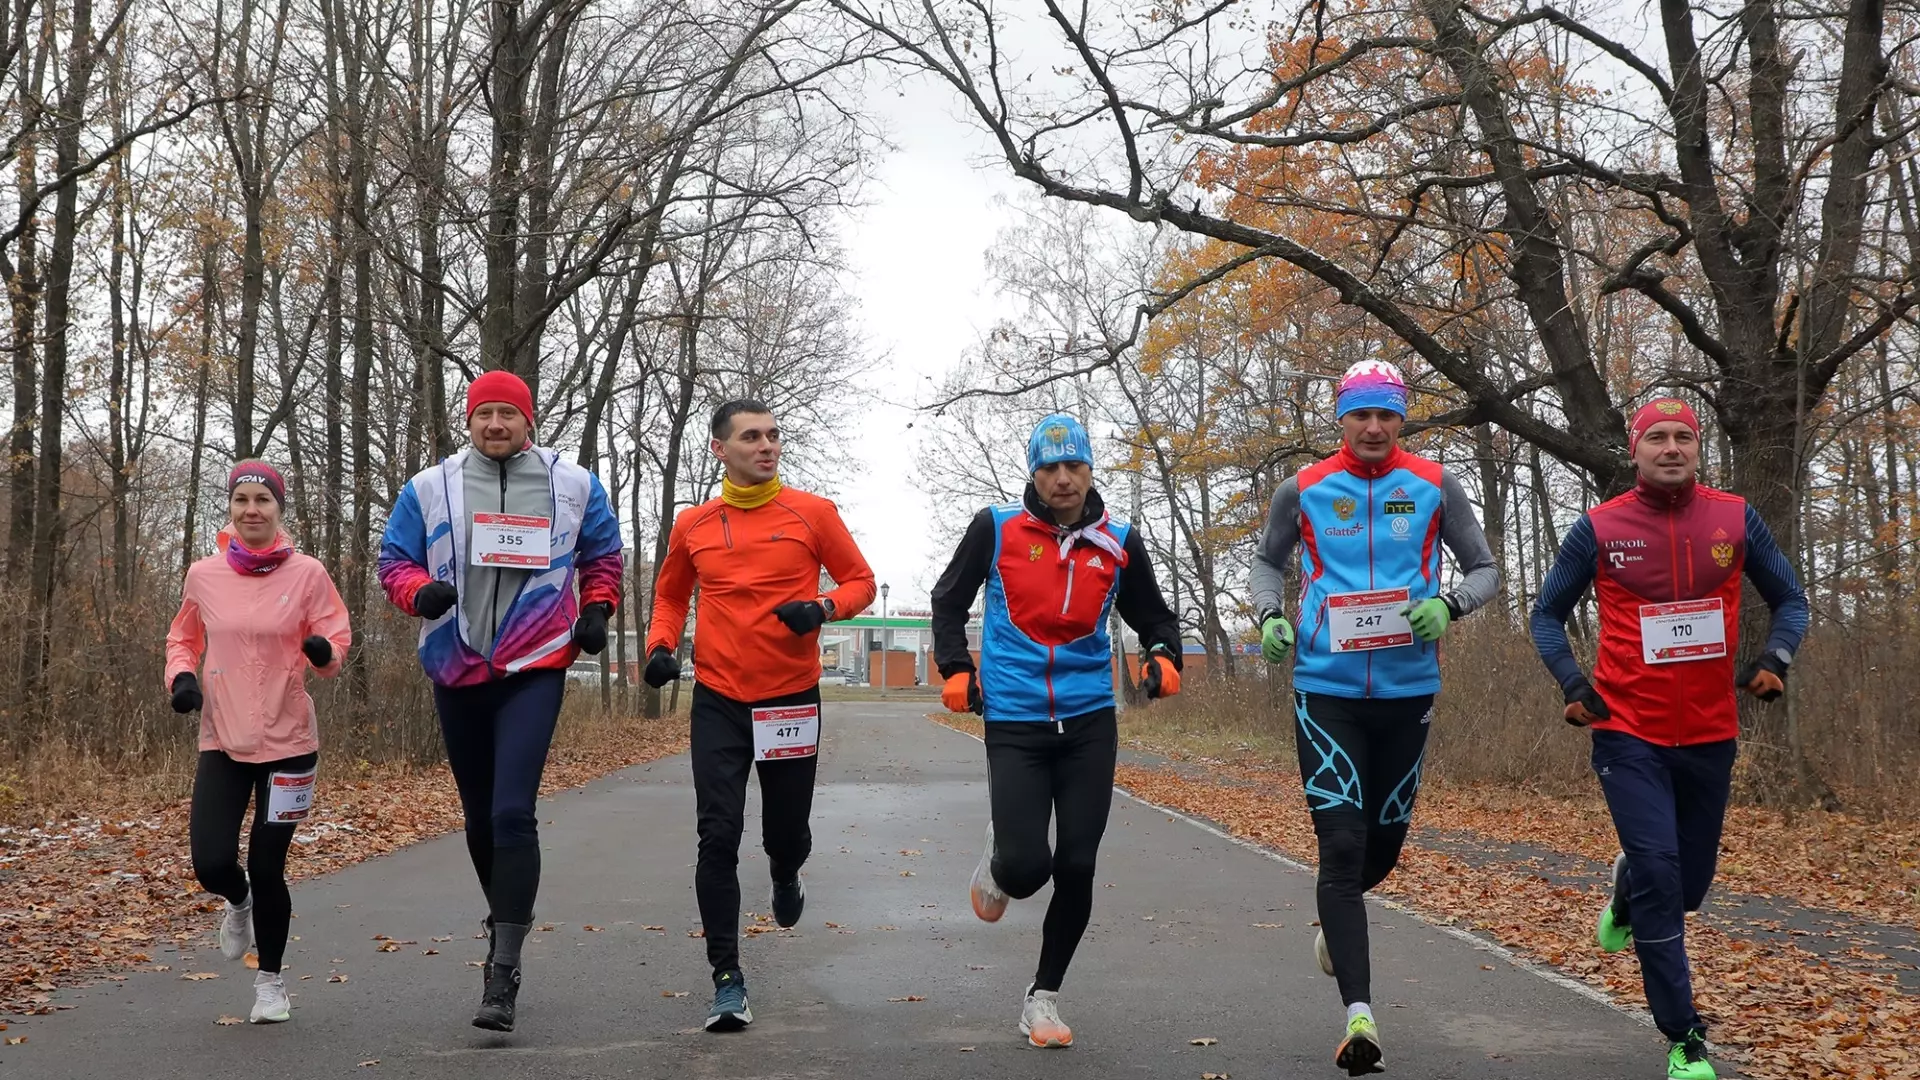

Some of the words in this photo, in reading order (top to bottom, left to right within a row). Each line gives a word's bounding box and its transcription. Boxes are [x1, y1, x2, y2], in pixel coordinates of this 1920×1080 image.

[1042, 443, 1076, 458] RUS
[498, 534, 523, 546] 355
[1605, 539, 1647, 549] LUKOIL
[1356, 615, 1382, 627] 247
[1671, 624, 1692, 637] 170
[777, 727, 800, 737] 477
[296, 794, 307, 803] 60
